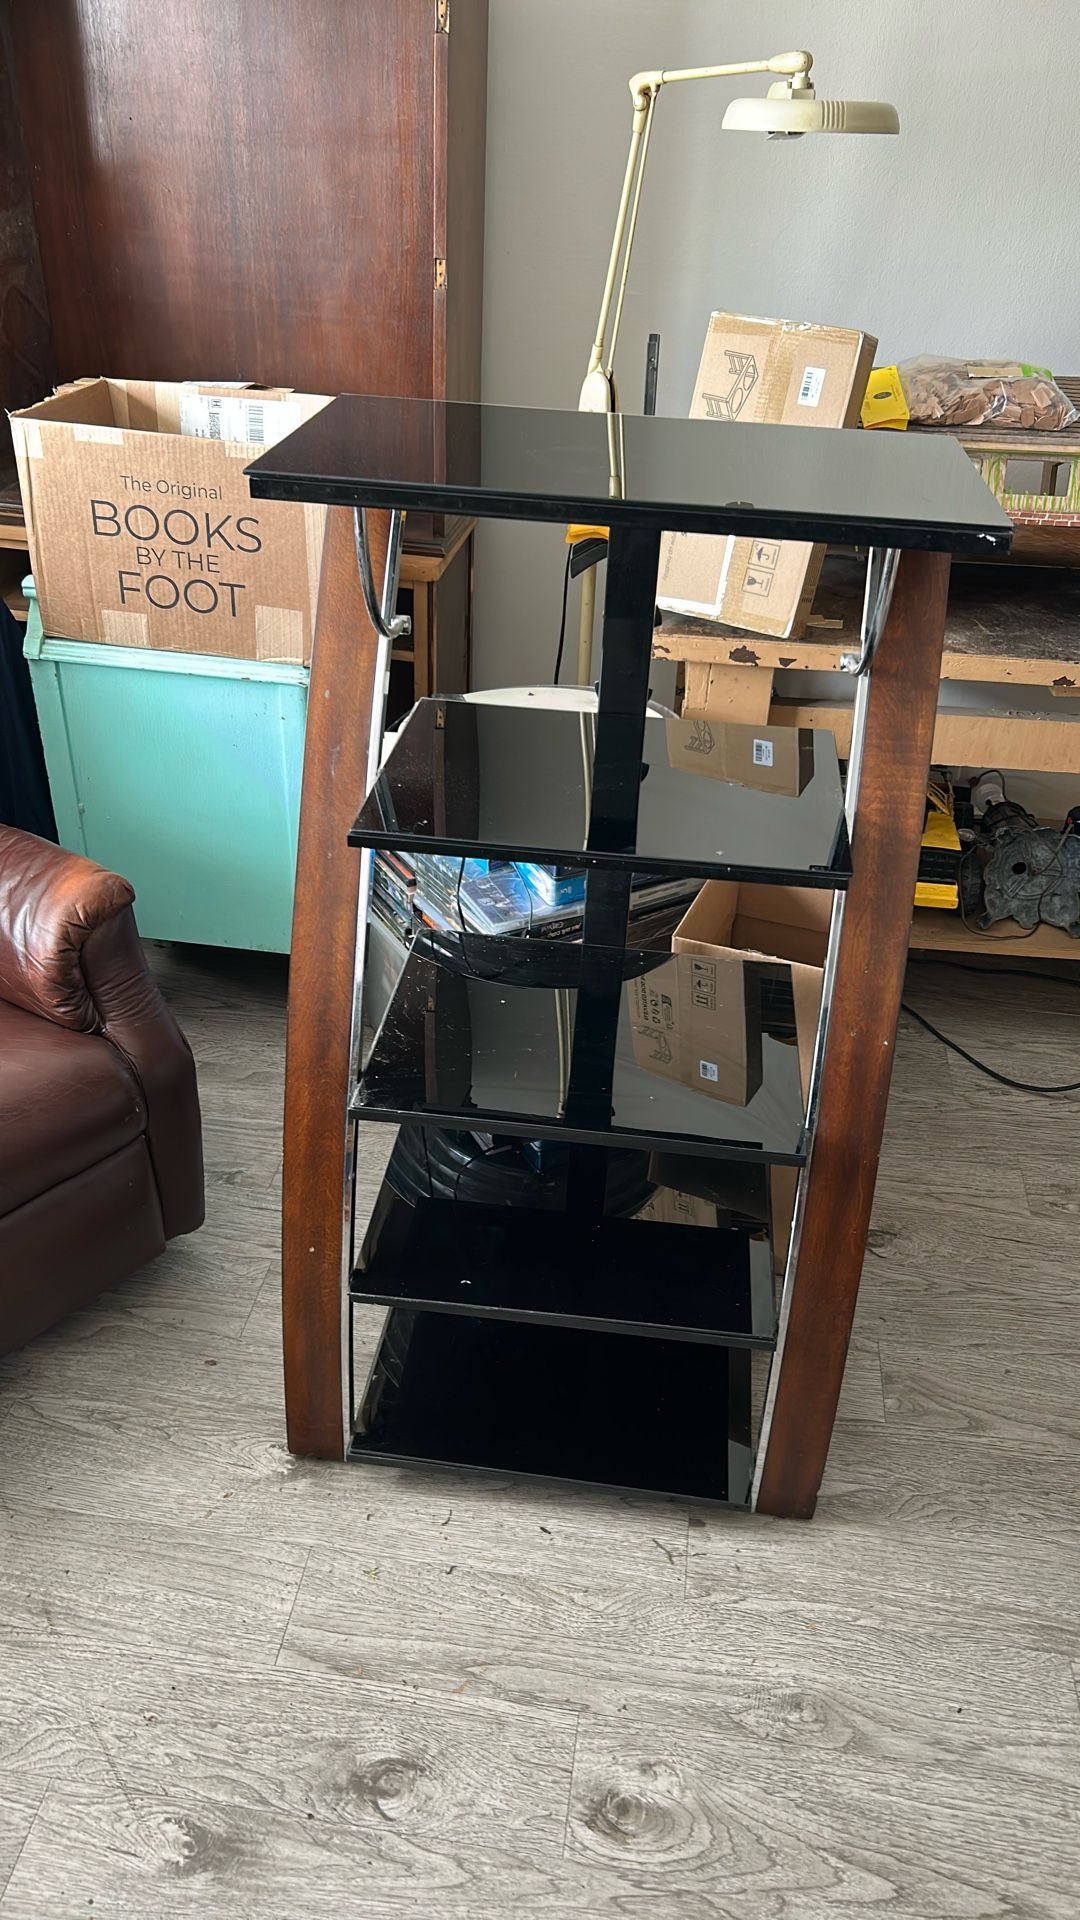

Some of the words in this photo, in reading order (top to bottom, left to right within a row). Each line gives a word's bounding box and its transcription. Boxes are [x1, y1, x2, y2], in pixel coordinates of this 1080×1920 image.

[120, 475, 151, 492] The
[156, 480, 223, 500] Original
[90, 499, 262, 553] BOOKS
[136, 546, 166, 567] BY
[172, 550, 220, 573] THE
[118, 570, 246, 617] FOOT
